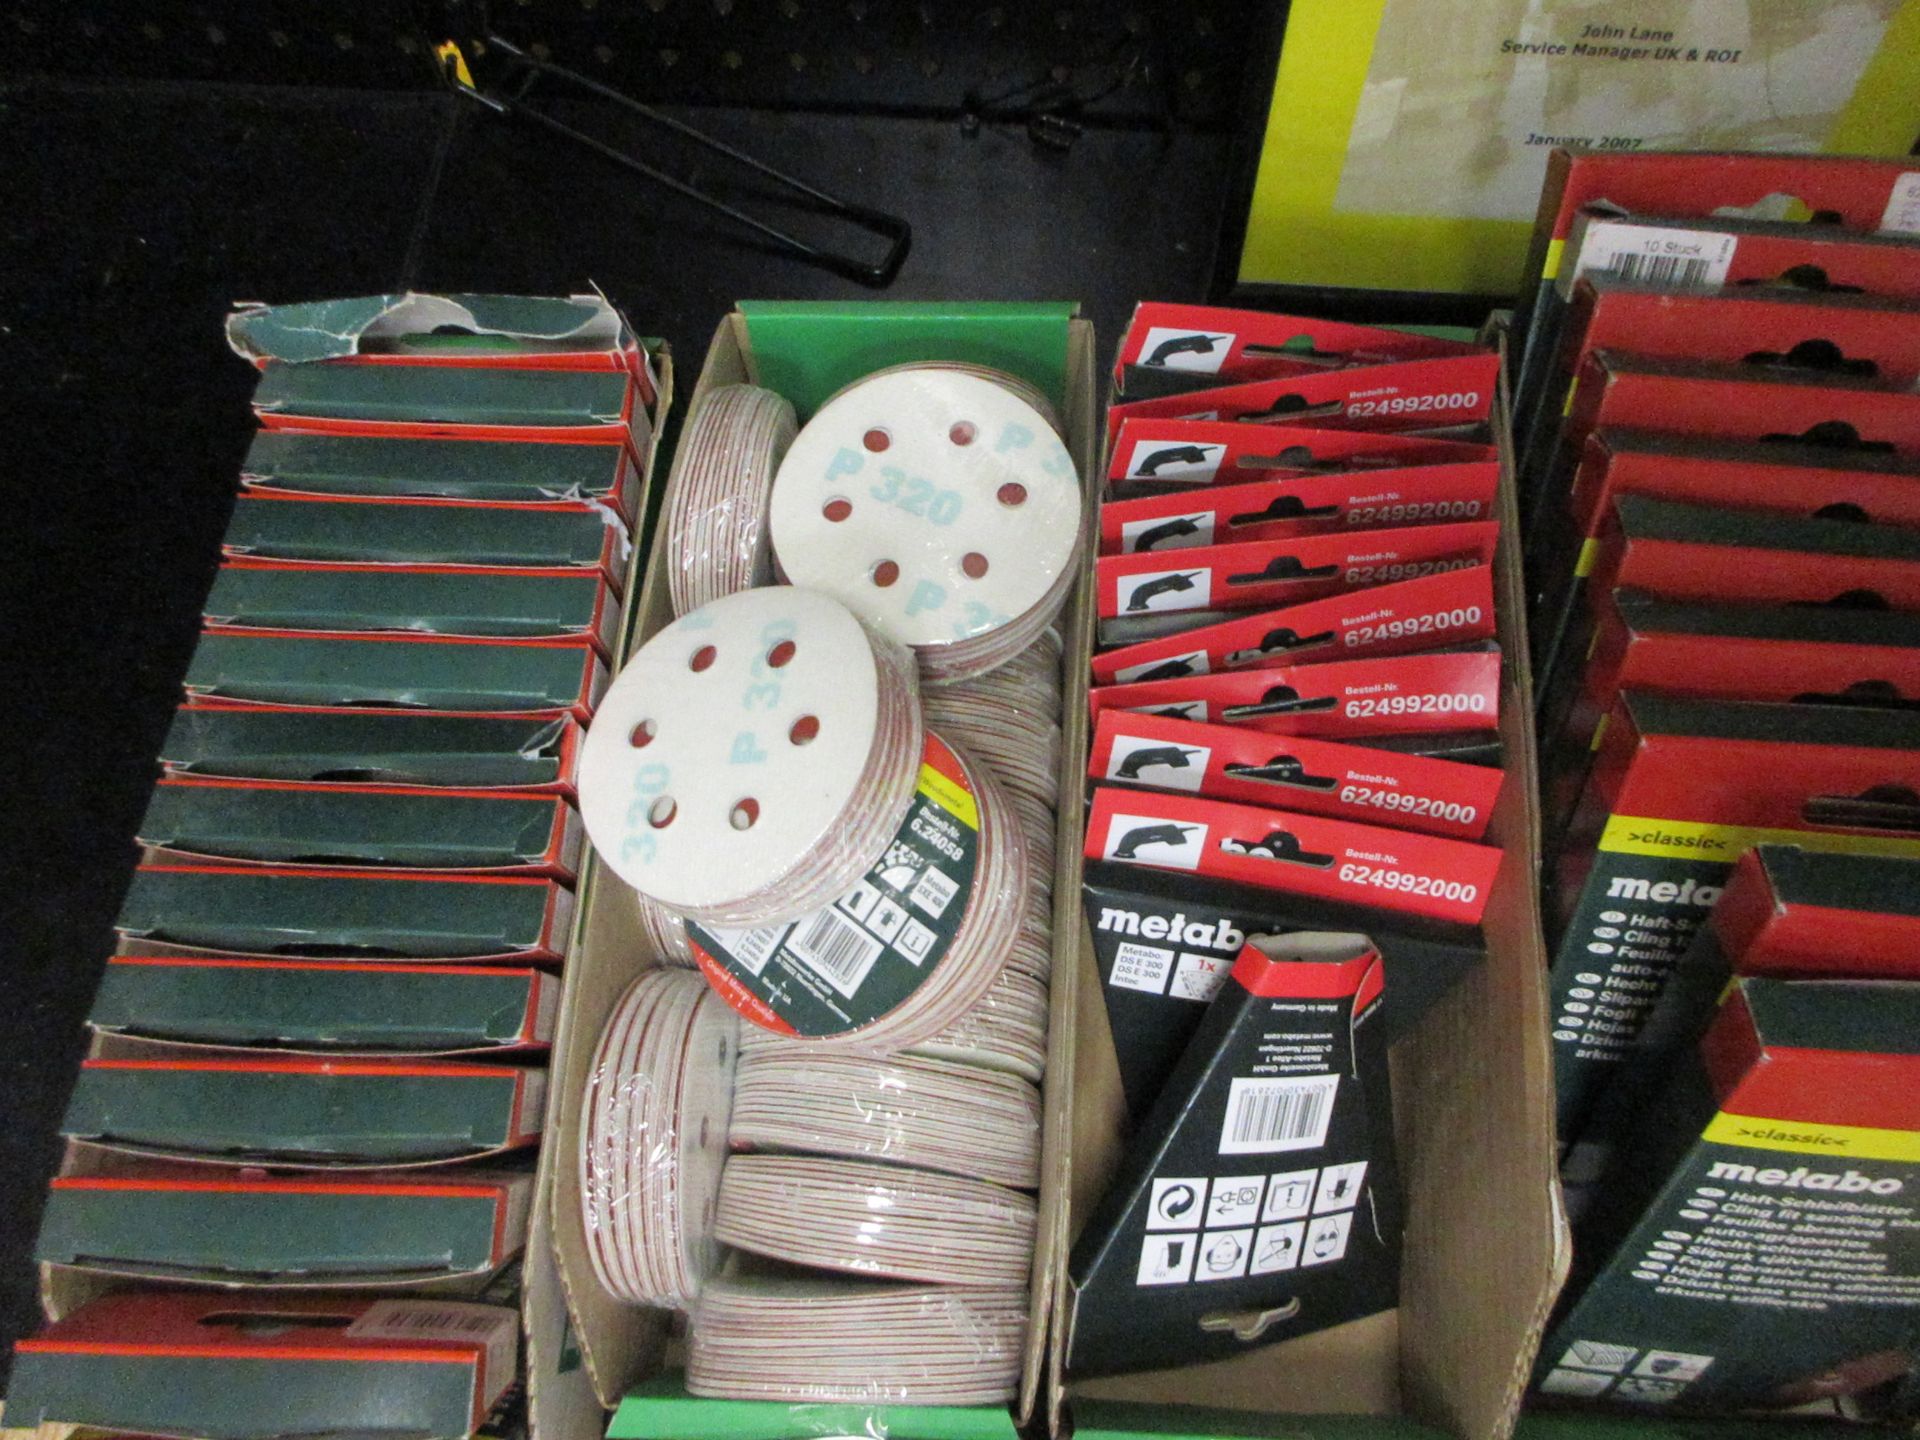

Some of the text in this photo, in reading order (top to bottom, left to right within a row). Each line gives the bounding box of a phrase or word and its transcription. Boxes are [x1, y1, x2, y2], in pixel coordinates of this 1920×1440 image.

[1580, 24, 1674, 42] John Lane
[1501, 40, 1742, 63] Service Manager UK & ROI
[1525, 133, 1643, 149] January 2007
[1644, 240, 1659, 252] 10
[1347, 392, 1479, 418] 624992000
[825, 447, 963, 526] P 320
[1347, 500, 1481, 524] 624992000
[1344, 606, 1481, 647] 624992000
[1345, 693, 1486, 718] 624992000
[1340, 785, 1477, 825] 624992000
[908, 816, 965, 862] 6.24058
[1339, 863, 1478, 903] 624992000
[1606, 877, 1724, 906] meta
[1097, 907, 1245, 951] metab
[1624, 930, 1671, 947] Cling
[1142, 970, 1161, 979] 300
[1145, 960, 1163, 969] 300
[1198, 959, 1216, 972] 1x
[1706, 1161, 1903, 1195] metabo
